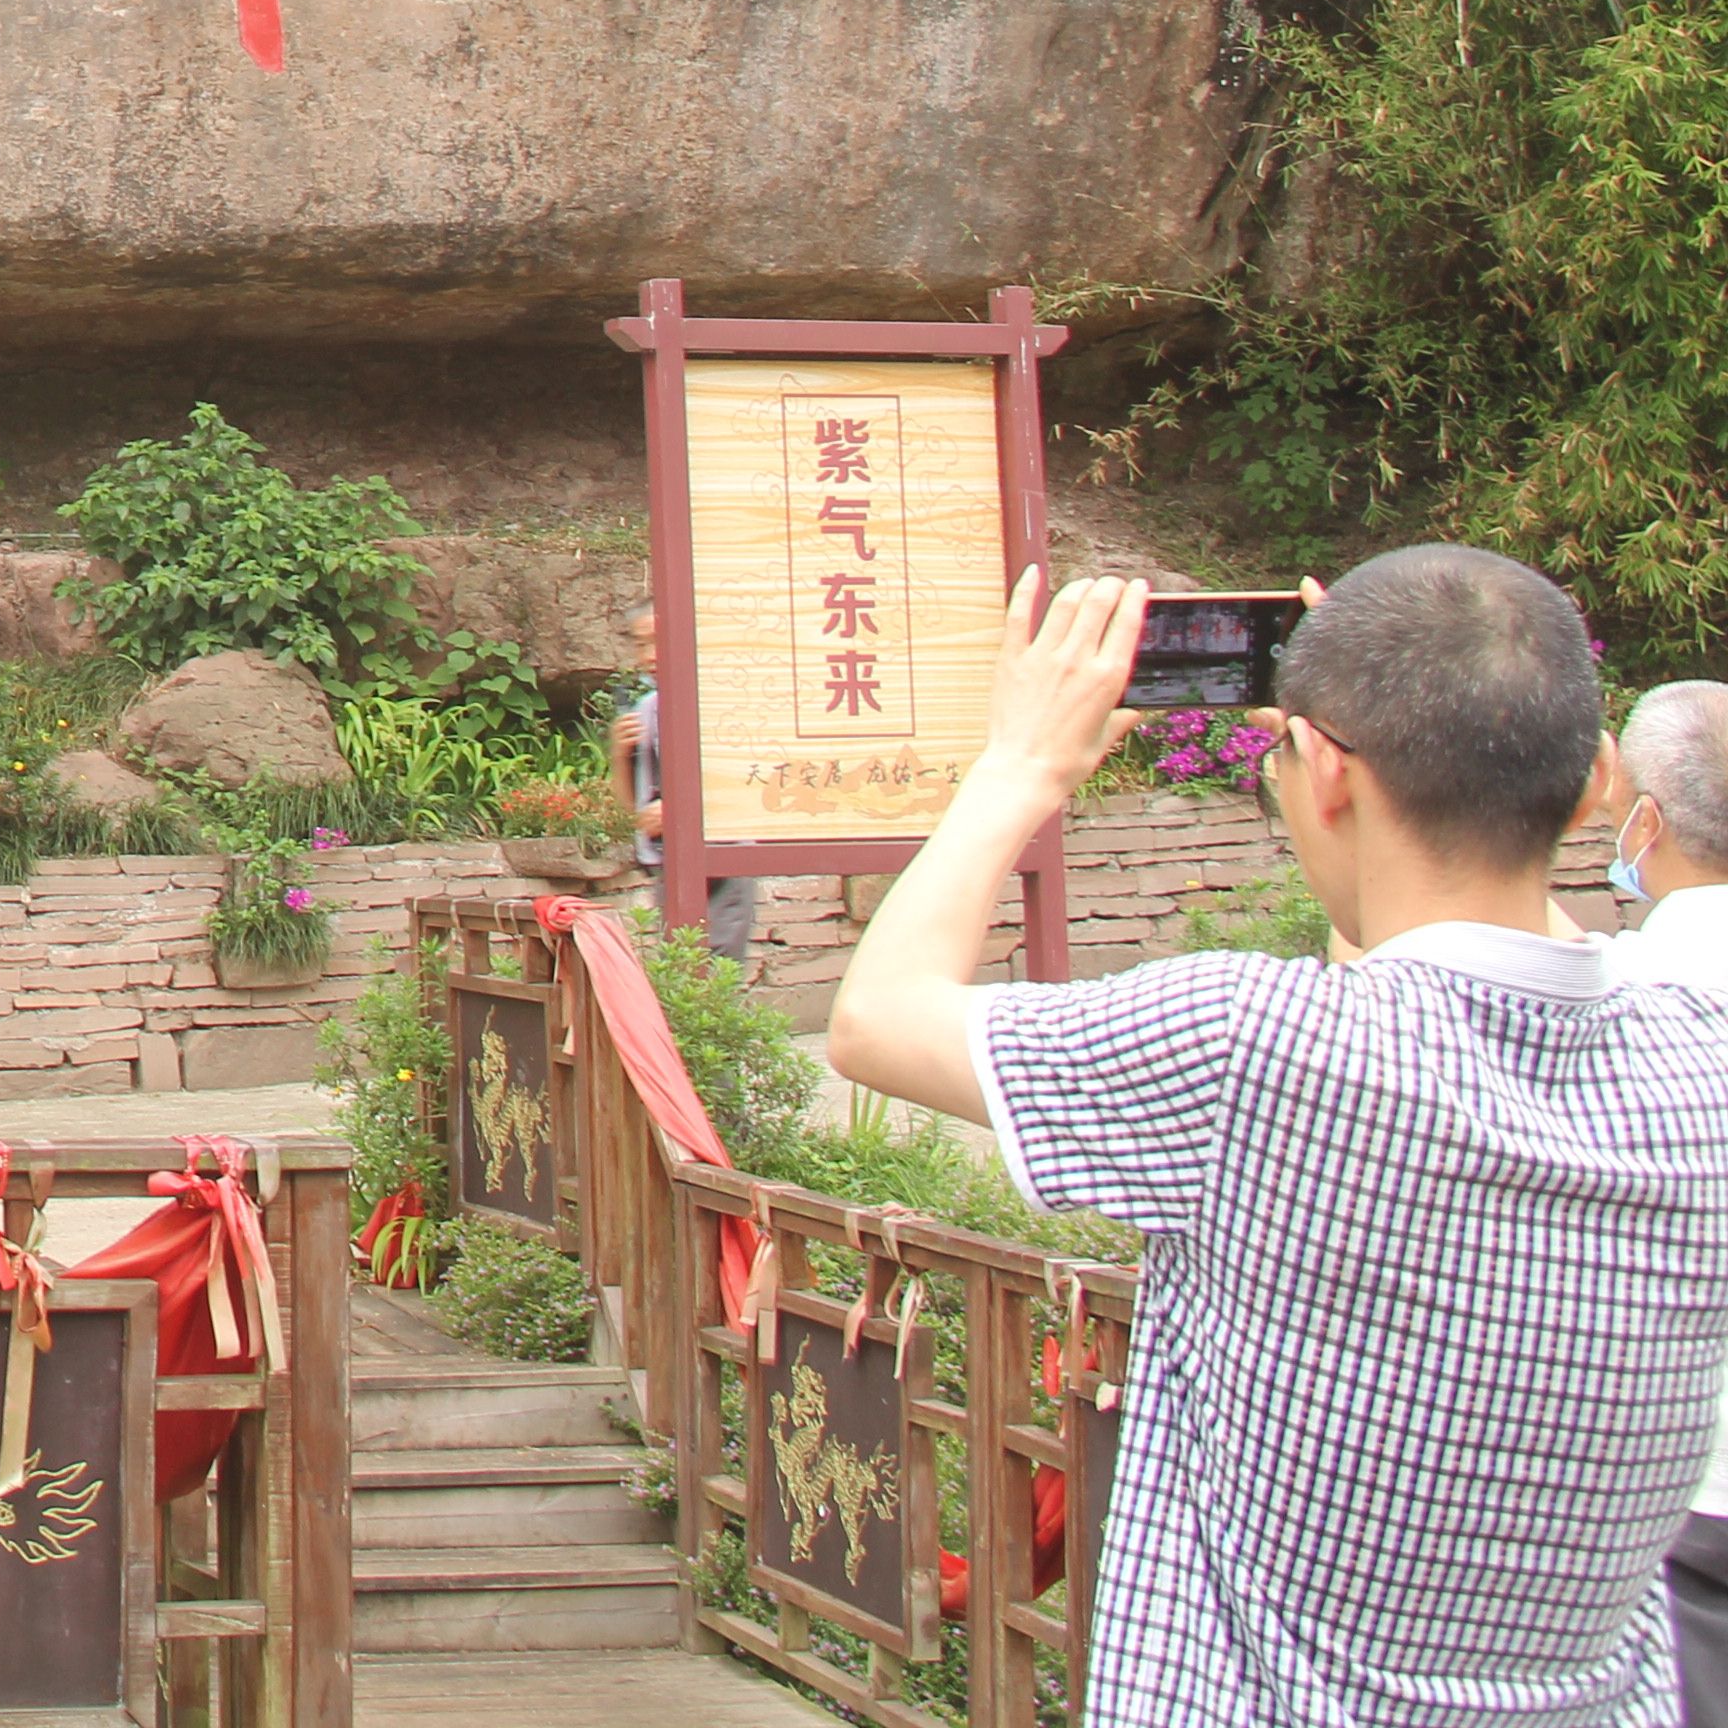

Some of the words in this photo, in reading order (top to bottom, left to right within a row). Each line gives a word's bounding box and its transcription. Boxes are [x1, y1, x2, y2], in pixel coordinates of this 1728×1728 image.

[813, 416, 884, 718] 紫气东来
[745, 760, 844, 789] 天下安居
[865, 758, 962, 786] 龙佑一生
